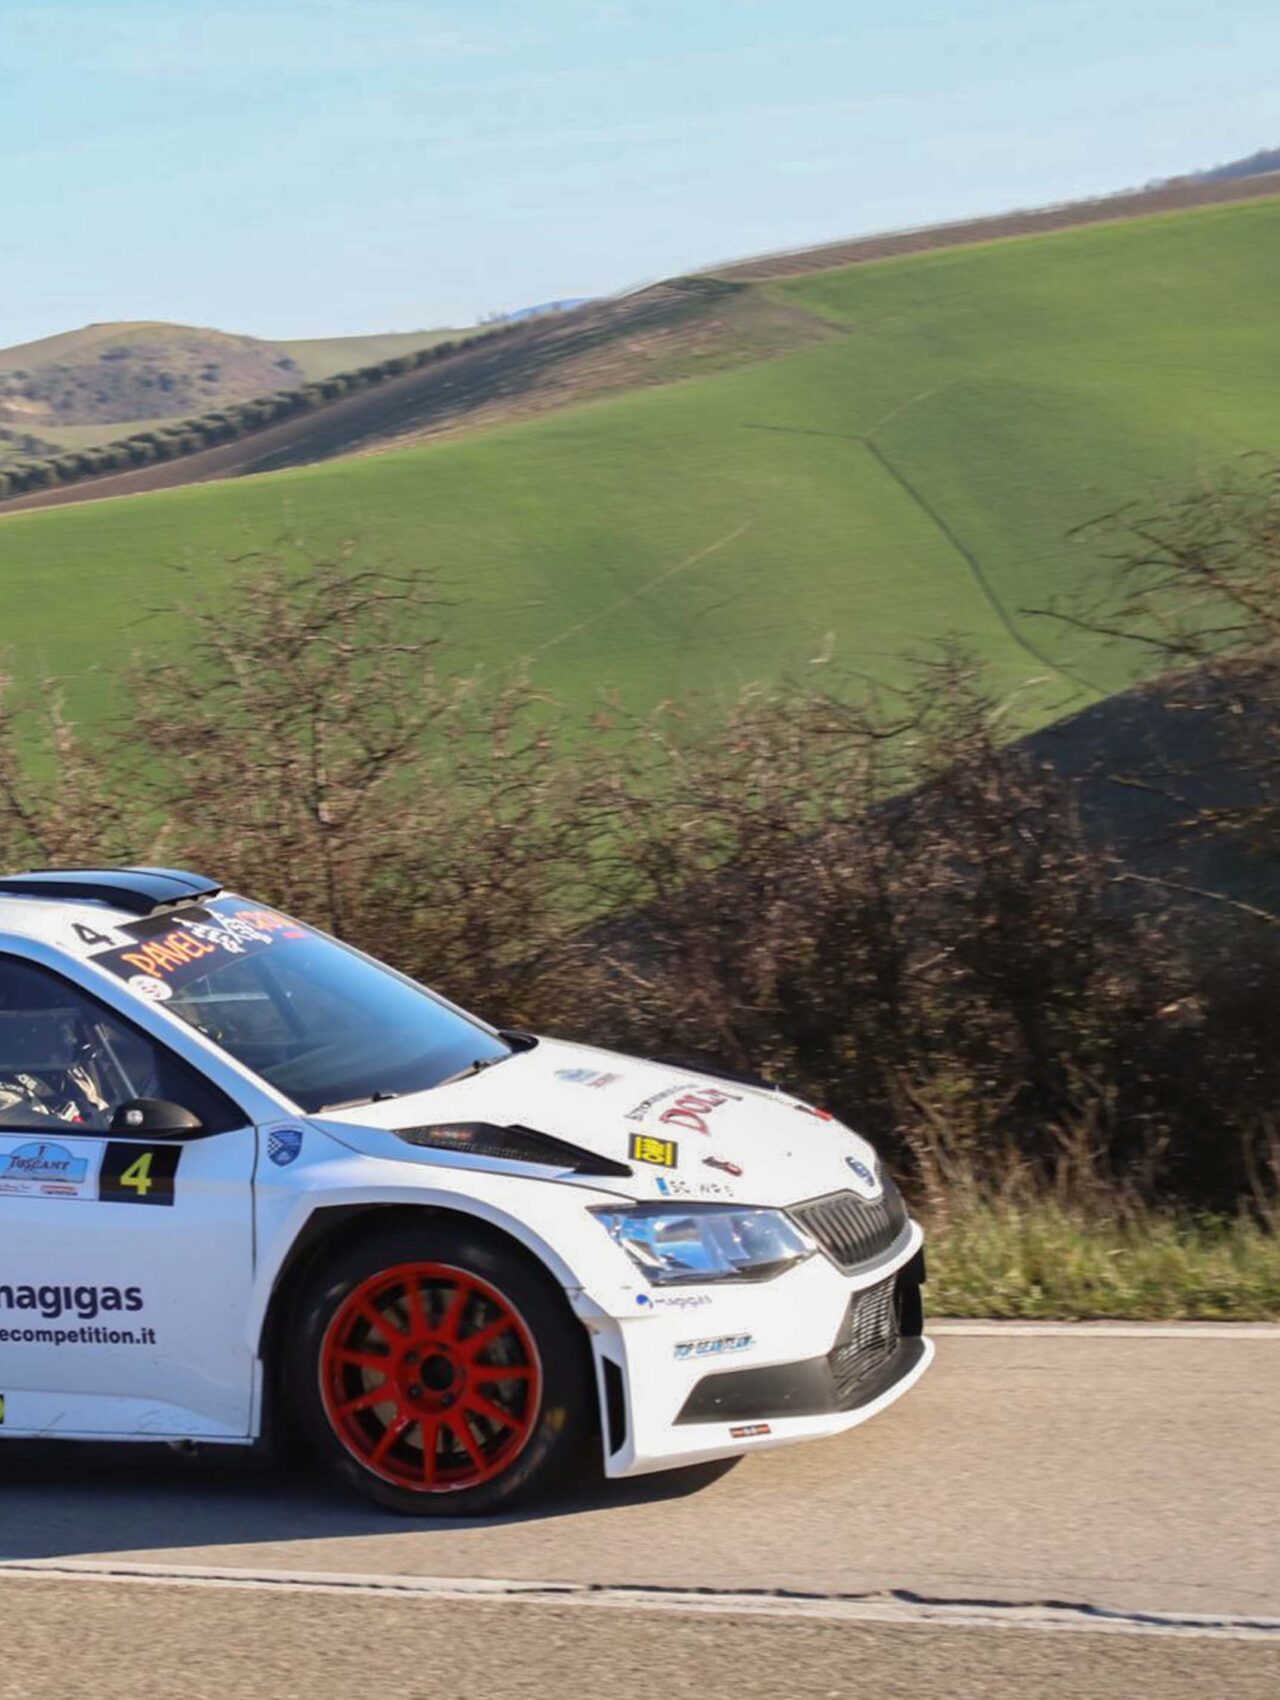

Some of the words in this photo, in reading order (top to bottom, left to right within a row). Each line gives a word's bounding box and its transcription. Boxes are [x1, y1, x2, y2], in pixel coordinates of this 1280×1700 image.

[71, 922, 116, 947] 4
[121, 931, 215, 977] PAVEL
[120, 1152, 154, 1195] 4
